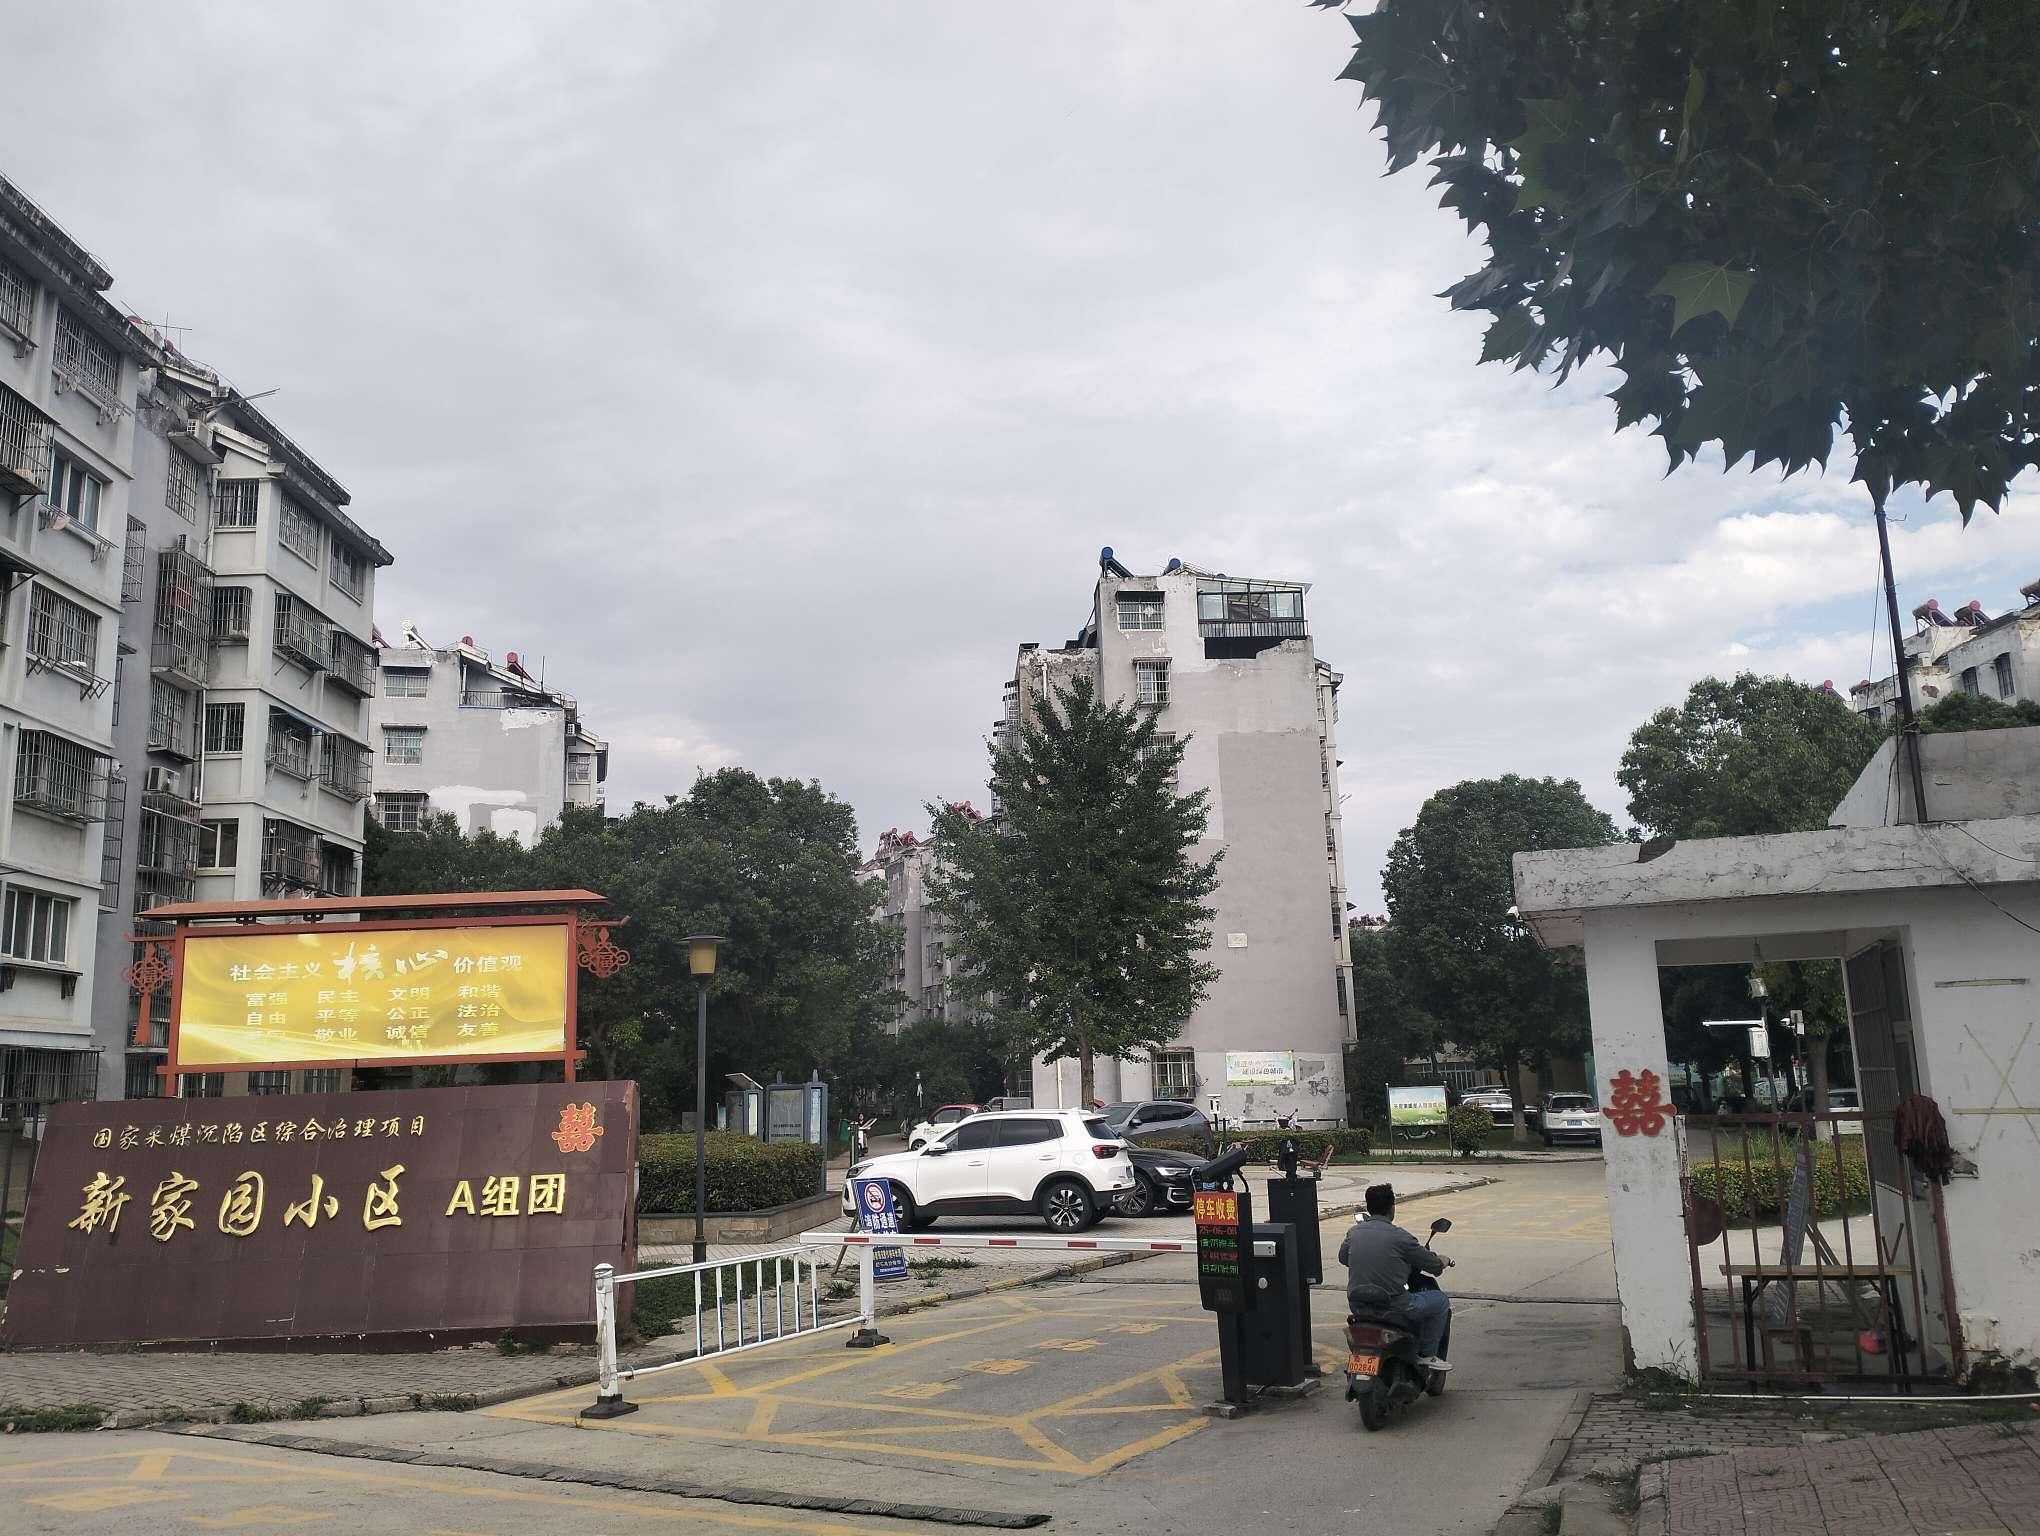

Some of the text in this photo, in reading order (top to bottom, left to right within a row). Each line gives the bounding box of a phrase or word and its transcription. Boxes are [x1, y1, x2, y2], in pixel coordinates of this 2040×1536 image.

[230, 942, 523, 985] 社会主义 核心 价值观
[246, 984, 502, 1007] 富强 民主 文明 和谐
[246, 1003, 501, 1026] 自由 平等 公正 法治
[314, 1022, 500, 1041] 敬业 诚信 友善
[93, 1115, 425, 1150] 国家采煤沉陷区综合治理项目
[68, 1164, 566, 1243] 新家园小区 A组团
[1196, 1198, 1236, 1220] 停车收费
